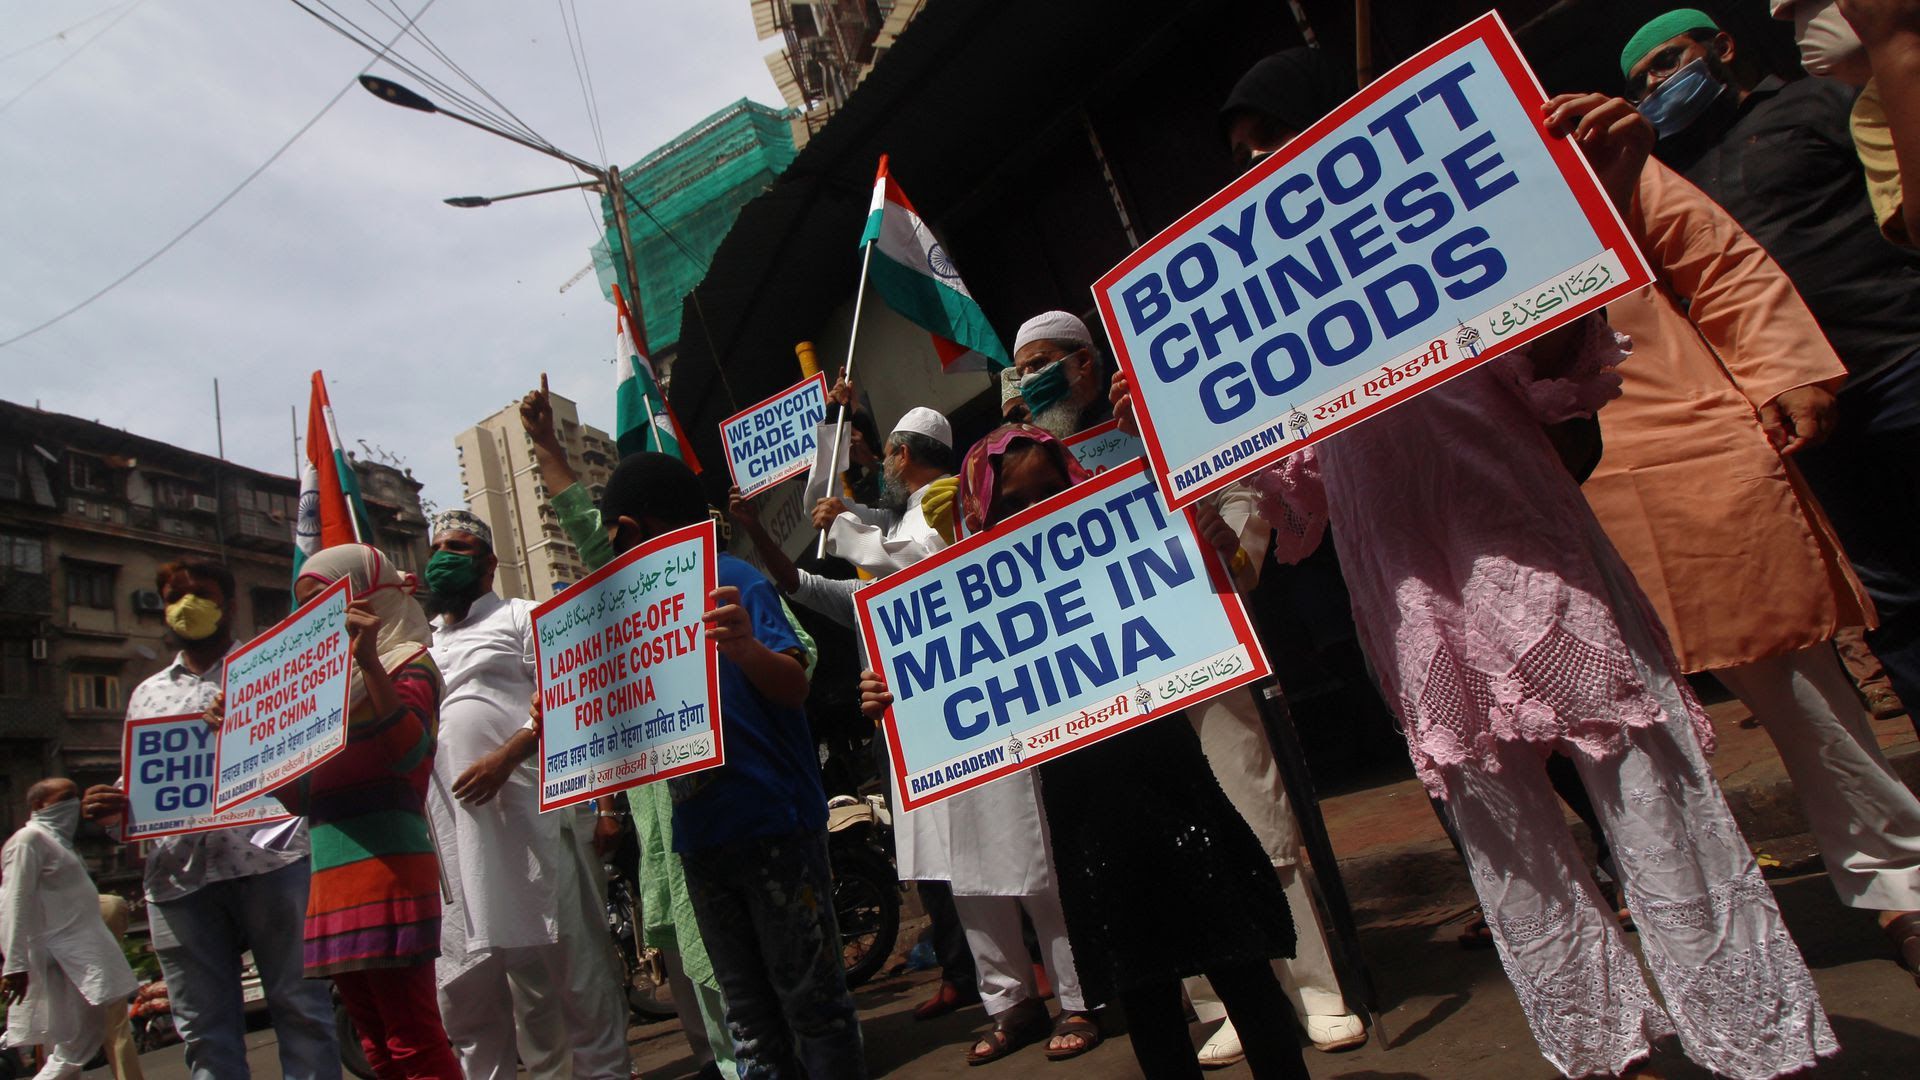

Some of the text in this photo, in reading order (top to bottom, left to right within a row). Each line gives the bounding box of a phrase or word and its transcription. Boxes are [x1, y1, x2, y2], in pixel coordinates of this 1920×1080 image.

[1121, 61, 1476, 336] BOYCOTT
[1149, 130, 1520, 383] CHINESE
[1199, 226, 1508, 424] GOODS
[1362, 339, 1448, 397] एकेडमी
[727, 384, 819, 444] WE BOYCOTT
[732, 405, 824, 464] MADE IN
[748, 433, 816, 478] CHINA
[1174, 423, 1285, 491] RAZA ACADEMY
[628, 571, 661, 602] جھڑپ
[664, 551, 696, 587] لداخ
[877, 481, 1168, 647] WE BOYCOTT
[555, 610, 573, 637] ثابت
[597, 591, 606, 619] کو
[608, 588, 627, 612] چین
[892, 535, 1195, 701] MADE IN
[549, 592, 685, 681] LADAKH FACE-OFF
[225, 651, 347, 736] WILL PROVE COSTLY
[231, 631, 341, 710] LADAKH FACE-OFF
[545, 622, 699, 712] WILL PROVE COSTLY
[943, 615, 1176, 741] CHINA
[250, 694, 317, 745] FOR CHINA
[575, 674, 656, 731] FOR CHINA
[589, 732, 605, 757] चीन
[607, 724, 618, 752] को
[645, 708, 675, 740] साबित
[678, 700, 704, 731] होगा
[1066, 695, 1129, 735] एकेडमी
[155, 783, 213, 811] GO
[545, 774, 587, 799] RAZA ACADEMY
[911, 745, 1005, 794] RAZA ACADEMY
[148, 820, 185, 832] ACADEMY
